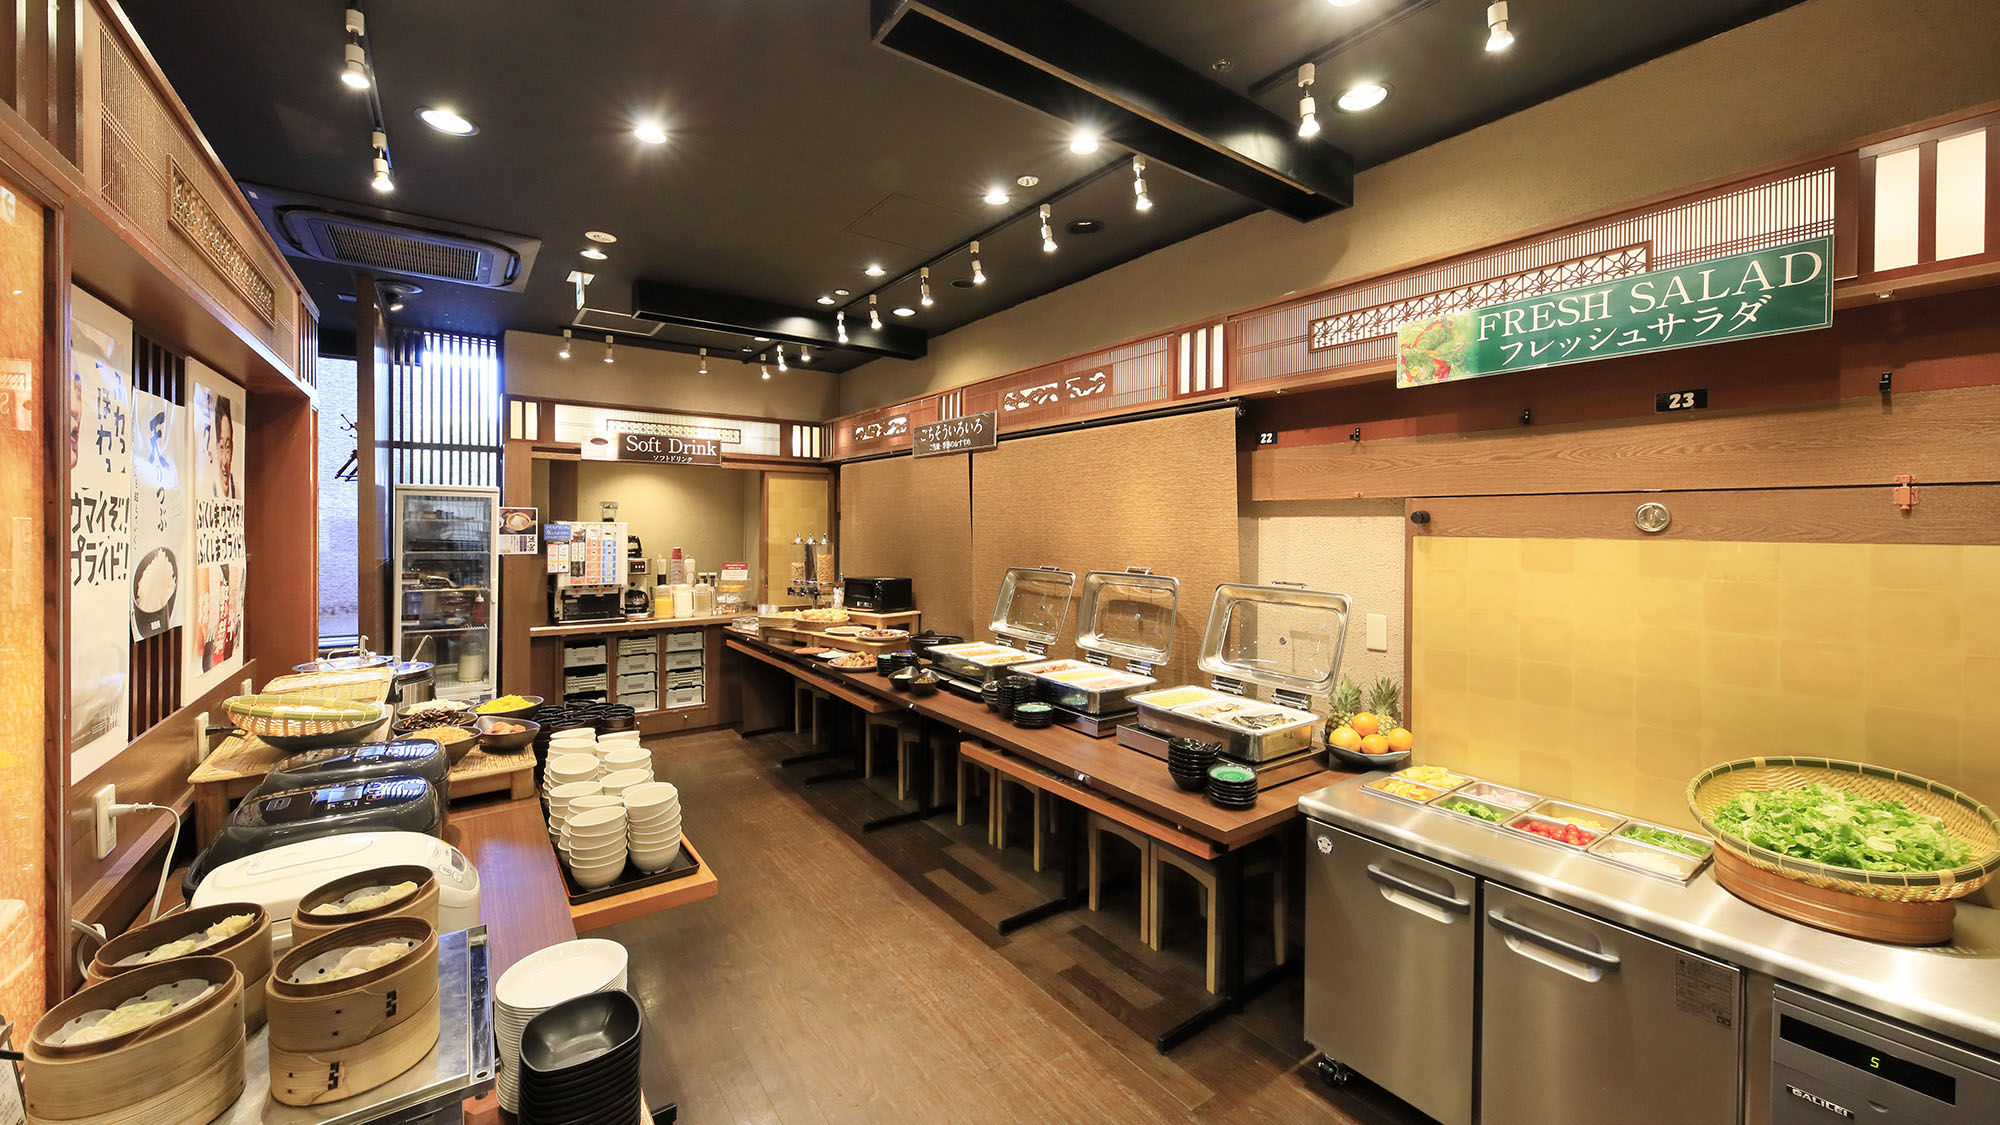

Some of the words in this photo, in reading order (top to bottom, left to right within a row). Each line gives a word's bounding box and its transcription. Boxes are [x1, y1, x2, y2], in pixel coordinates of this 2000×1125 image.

[1477, 289, 1613, 342] FRESH
[1630, 251, 1823, 314] SALAD
[1499, 294, 1773, 366] フレッシュサラダ
[1669, 392, 1695, 409] 23
[920, 418, 983, 442] ごちそういろいろ
[1260, 432, 1273, 444] 22
[626, 435, 662, 453] Soft
[668, 438, 717, 456] Drink
[653, 455, 693, 463] ソフトドリンク
